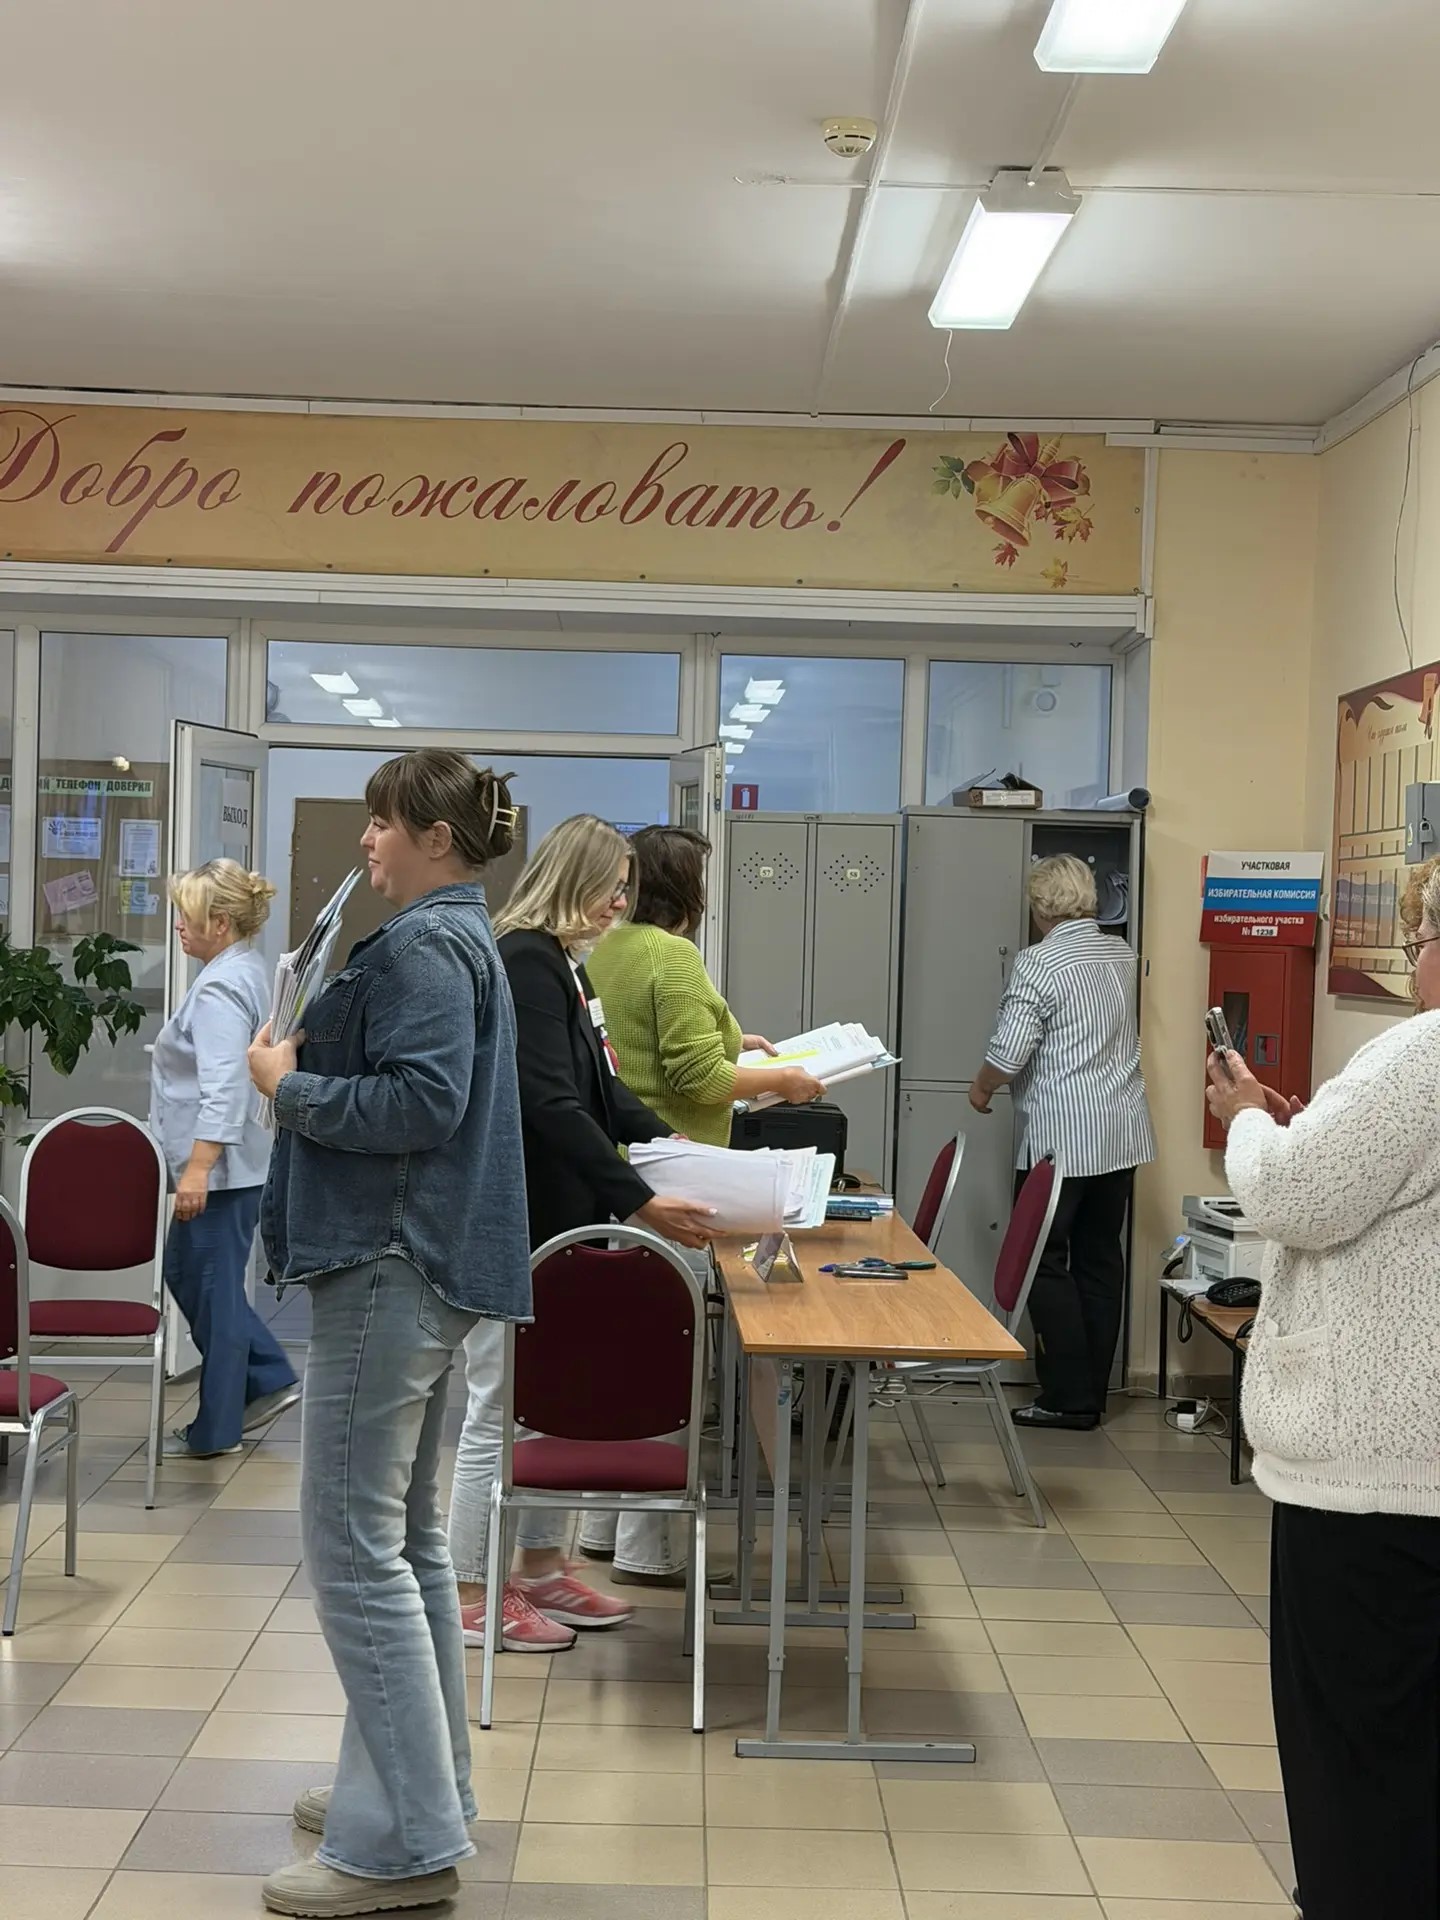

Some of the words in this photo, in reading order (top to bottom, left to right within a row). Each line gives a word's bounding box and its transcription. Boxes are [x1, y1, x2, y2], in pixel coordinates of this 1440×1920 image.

[0, 409, 242, 553] Добро
[286, 437, 906, 532] пожаловать!
[56, 778, 100, 790] ТЕЛЕФОН
[223, 805, 248, 828] ВЫХОД
[1241, 861, 1290, 870] УЧАСТКОВАЯ
[762, 869, 771, 877] 57
[1208, 888, 1272, 899] ИЗБИРАТЕЛЬНАЯ
[1273, 889, 1316, 900] КОМИССИЯ
[1214, 914, 1273, 925] избирательного
[1275, 916, 1304, 925] участка
